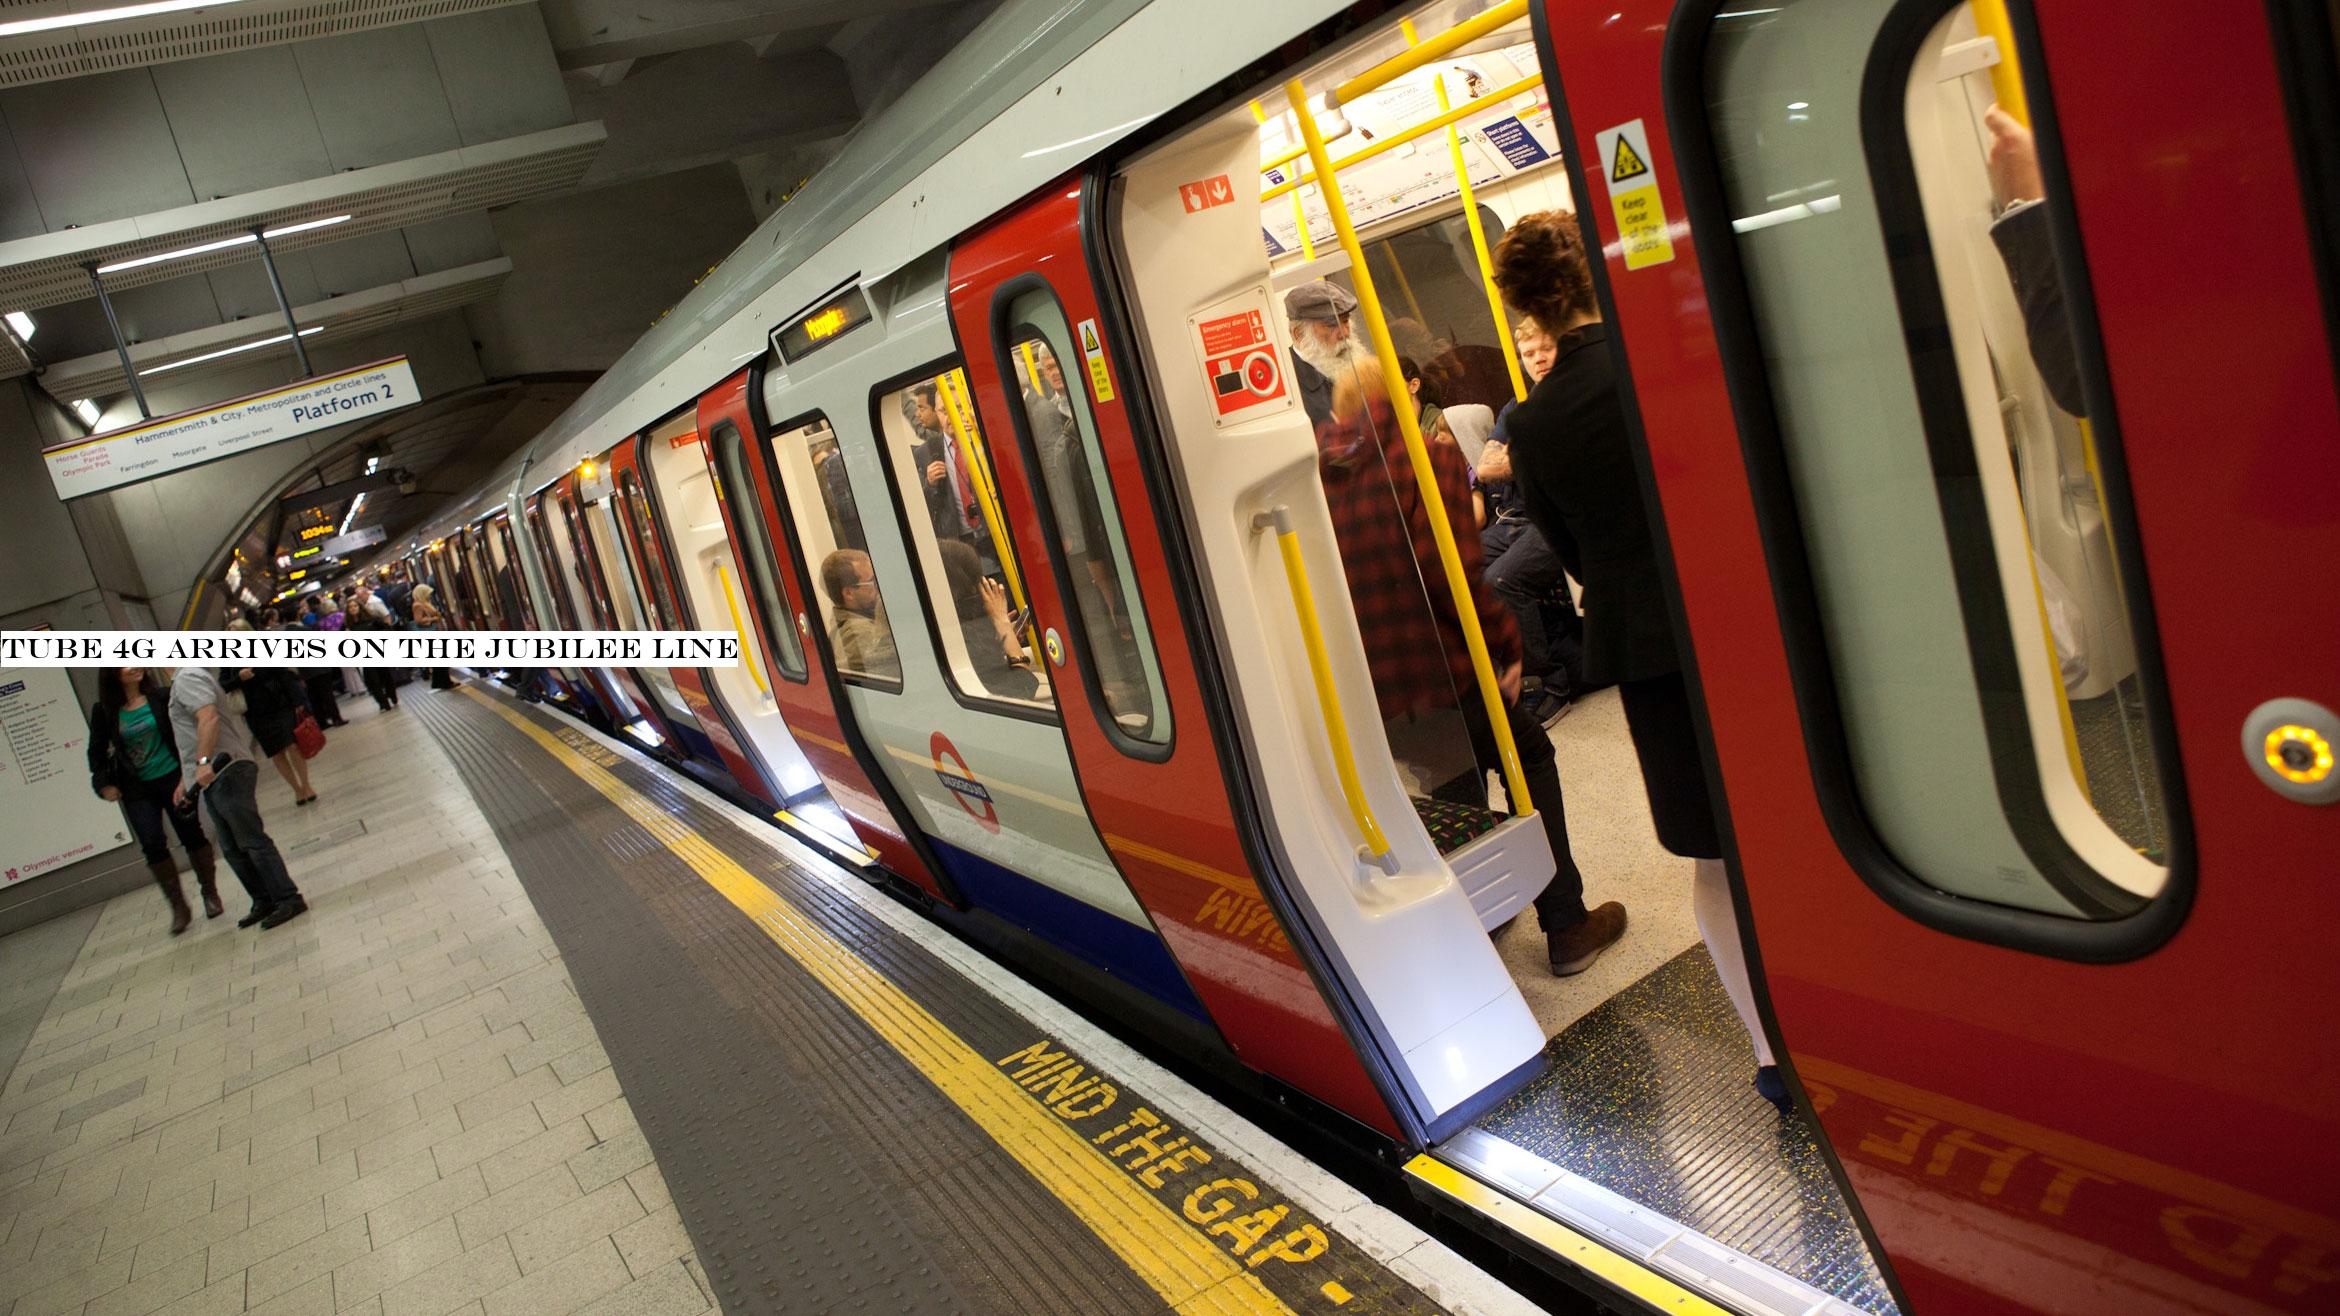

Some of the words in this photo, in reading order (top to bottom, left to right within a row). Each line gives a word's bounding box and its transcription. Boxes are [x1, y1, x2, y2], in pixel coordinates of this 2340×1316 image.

[1622, 197, 1646, 211] Keep
[1625, 212, 1648, 224] clear
[135, 421, 208, 445] Hammersmith
[210, 416, 218, 425] &
[247, 392, 312, 415] Metropolitan
[314, 386, 331, 398] and
[333, 379, 361, 392] Circle
[363, 373, 386, 384] lines
[292, 391, 378, 423] Platform
[381, 384, 394, 399] 2
[120, 458, 159, 473] Farringdon
[172, 445, 207, 458] Moorgate
[218, 434, 251, 446] Liverpool
[251, 427, 273, 437] Street
[62, 463, 94, 477] Olympic
[95, 460, 111, 469] Park
[22, 856, 60, 873] Olympic
[62, 843, 94, 858] venues
[997, 1040, 1118, 1120] MIND
[1092, 1107, 1212, 1189] THE
[1183, 1178, 1329, 1268] GAP
